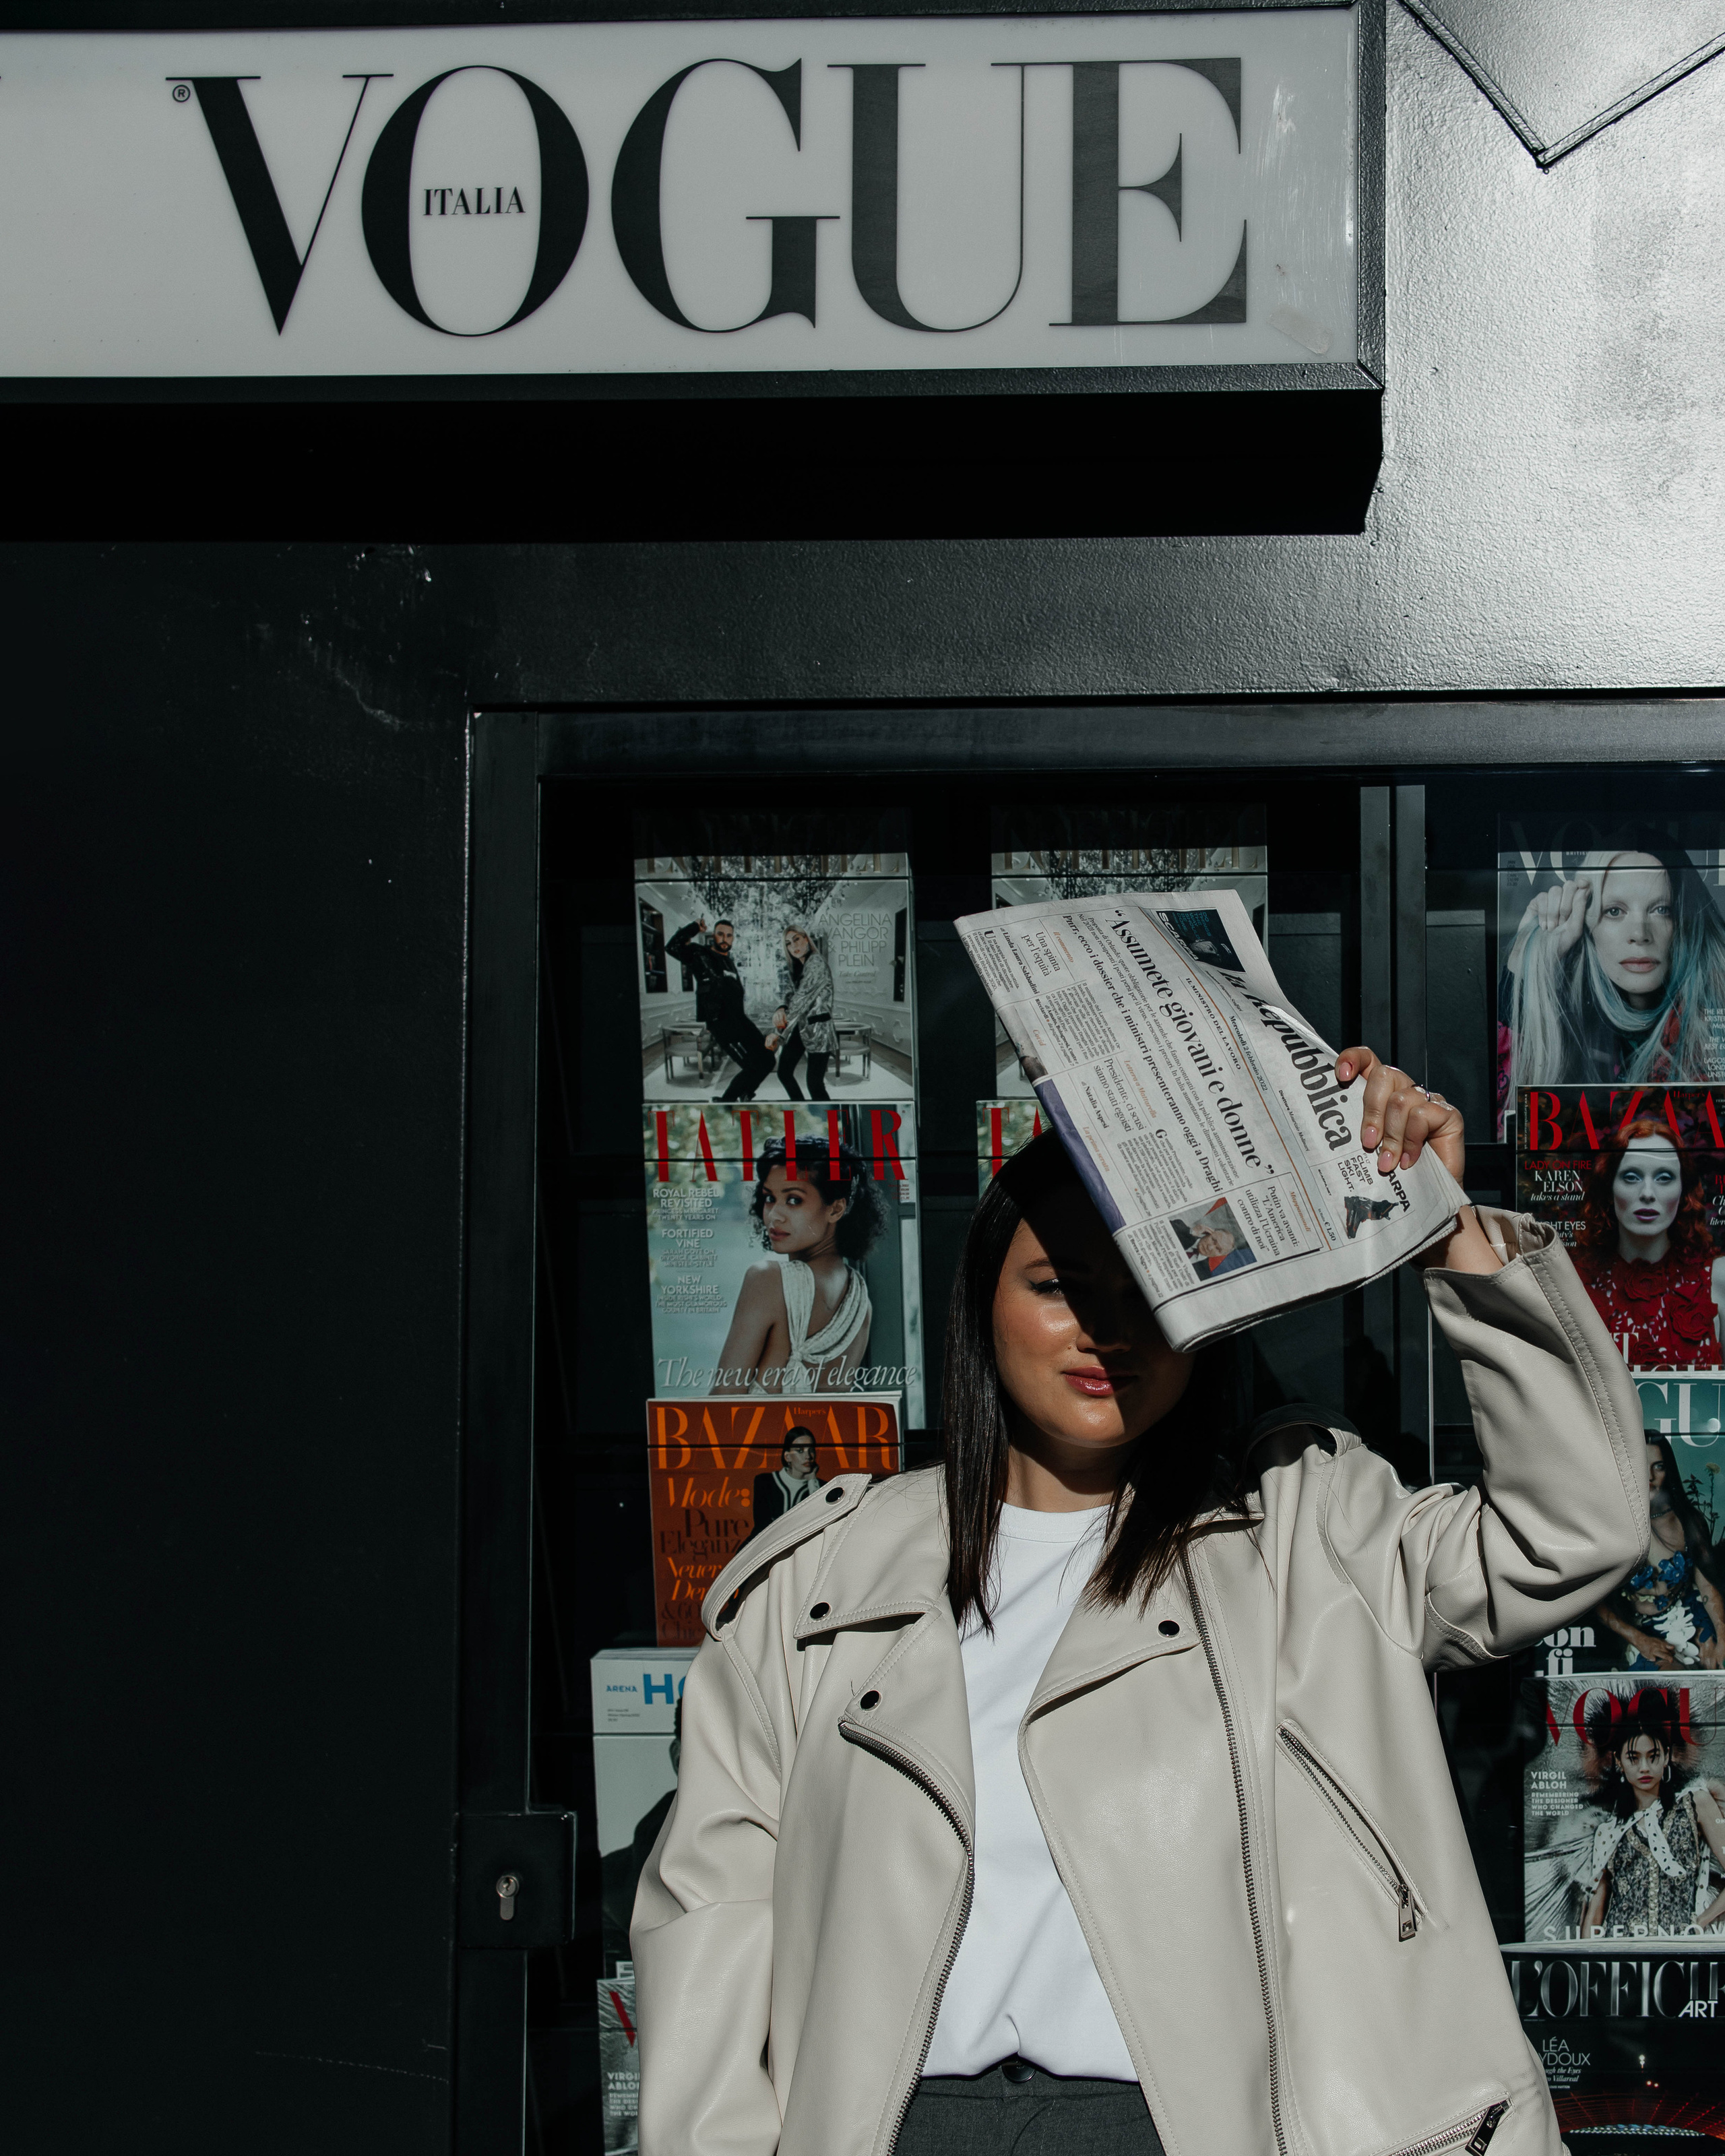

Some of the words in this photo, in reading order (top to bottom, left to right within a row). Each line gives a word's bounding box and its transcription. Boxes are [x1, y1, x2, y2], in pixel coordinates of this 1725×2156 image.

[166, 56, 1248, 336] VOGUE
[422, 186, 526, 217] ITALIA
[817, 912, 893, 926] ANGELINA
[824, 926, 889, 940] VANGOR
[1157, 909, 1201, 962] SCARPA
[840, 940, 887, 953] PHILIPP
[1021, 934, 1034, 947] per
[1030, 947, 1051, 976] l'equità
[1036, 931, 1047, 948] Una
[1043, 948, 1060, 971] spinta
[1056, 934, 1073, 962] commento
[838, 953, 875, 967] PLEIN
[1002, 932, 1013, 948] Linda
[1011, 949, 1023, 965] Laura
[1020, 965, 1040, 994] Sabbadini
[1217, 970, 1247, 990] la
[1190, 985, 1215, 1019] MINISTRO
[1213, 1020, 1223, 1036] DEL
[1222, 1036, 1241, 1069] LAVORO
[1032, 1029, 1046, 1046] Covid
[1159, 1002, 1222, 1077] giovani
[1208, 1080, 1224, 1092] e
[1062, 915, 1079, 934] Pnrr,
[1077, 935, 1092, 953] ecco
[1092, 959, 1115, 990] dossier
[1111, 992, 1124, 1008] che
[1124, 1015, 1151, 1053] ministri
[1142, 1055, 1185, 1124] presenteranno
[1183, 1126, 1200, 1147] oggi
[1199, 1156, 1223, 1192] Draghi
[1090, 931, 1100, 940] non
[1097, 940, 1117, 963] recuperati
[1112, 966, 1126, 978] posti
[1120, 979, 1133, 992] persi
[1127, 992, 1137, 1001] per
[1137, 1005, 1148, 1021] virus,
[1146, 1021, 1160, 1044] crescono
[1158, 1048, 1174, 1070] precari.
[1174, 1076, 1185, 1091] Italia
[1182, 1091, 1201, 1122] aumentano
[1202, 1128, 1221, 1157] dimissioni
[1217, 1158, 1234, 1186] volontarie
[1105, 939, 1121, 959] Orlando:
[1118, 959, 1129, 972] quote
[1127, 973, 1148, 1003] obbligatorie
[1143, 1003, 1153, 1011] per
[1153, 1018, 1168, 1039] aziende
[1164, 1039, 1172, 1049] che
[1170, 1050, 1181, 1066] fanno
[1179, 1067, 1195, 1090] contratti
[1191, 1090, 1199, 1101] con
[1198, 1106, 1215, 1131] pubblica
[1212, 1131, 1239, 1178] amministrazione
[1229, 1015, 1247, 1046] Mercoledì
[1245, 1050, 1259, 1075] febbraio
[1256, 1075, 1267, 1091] 2022
[1103, 1058, 1128, 1103] Presidente,
[1123, 1060, 1137, 1081] Lettera
[1137, 1087, 1156, 1118] Mattarella
[1084, 1085, 1097, 1108] Natalia
[1094, 1110, 1109, 1129] Aspesi
[1093, 1065, 1109, 1088] siamo
[1105, 1089, 1121, 1106] stati
[1114, 1107, 1133, 1132] egoisti
[1125, 1103, 1136, 1111] ci
[1278, 1089, 1290, 1110] Direttore
[1129, 1111, 1146, 1130] scusi
[648, 1109, 909, 1182] TATLER
[1344, 1159, 1354, 1176] SKI
[1350, 1157, 1365, 1182] FAST
[1356, 1155, 1373, 1184] CLIMB
[1524, 1160, 1551, 1170] LADY
[1552, 1160, 1571, 1170] ON
[1573, 1160, 1592, 1170] FIRE
[1337, 1162, 1354, 1192] LIGHT.
[1534, 1170, 1581, 1182] KAREN
[652, 1187, 687, 1199] ROYAL
[688, 1187, 720, 1198] REBEL
[1530, 1191, 1552, 1201] takes
[1561, 1191, 1586, 1201] stand
[1543, 1181, 1583, 1192] ELSON
[660, 1198, 713, 1208] REVISITED
[1290, 1191, 1311, 1232] Mappamondi
[1237, 1199, 1253, 1225] contro
[1251, 1226, 1260, 1234] di
[1245, 1189, 1262, 1218] utilizza
[1259, 1217, 1280, 1256] l'Ucraina
[1267, 1186, 1281, 1208] Putin
[1278, 1209, 1286, 1219] va
[1282, 1219, 1299, 1246] avanti:
[1565, 1220, 1586, 1230] EYES
[662, 1228, 714, 1238] FORTIFIED
[1326, 1227, 1336, 1240] 1,50
[675, 1239, 701, 1248] VINE
[661, 1284, 719, 1294] YORKSHIRE
[677, 1275, 701, 1284] NEW
[656, 1356, 702, 1389] The
[708, 1366, 760, 1387] new
[762, 1366, 802, 1387] era
[803, 1355, 829, 1391] of
[827, 1355, 917, 1393] elegance
[793, 1407, 827, 1416] Harper's
[668, 1476, 751, 1508] Mode:
[684, 1508, 750, 1538] Pure
[606, 1685, 638, 1693] ARENA
[1530, 1771, 1567, 1780] VIRGIL
[1530, 1781, 1567, 1789] ABLOH
[1678, 2000, 1719, 2018] ART
[1542, 2035, 1570, 2053] LÉA
[1538, 2052, 1591, 2066] YDOUX
[1557, 2066, 1567, 2074] the
[1567, 2066, 1582, 2075] Eyes
